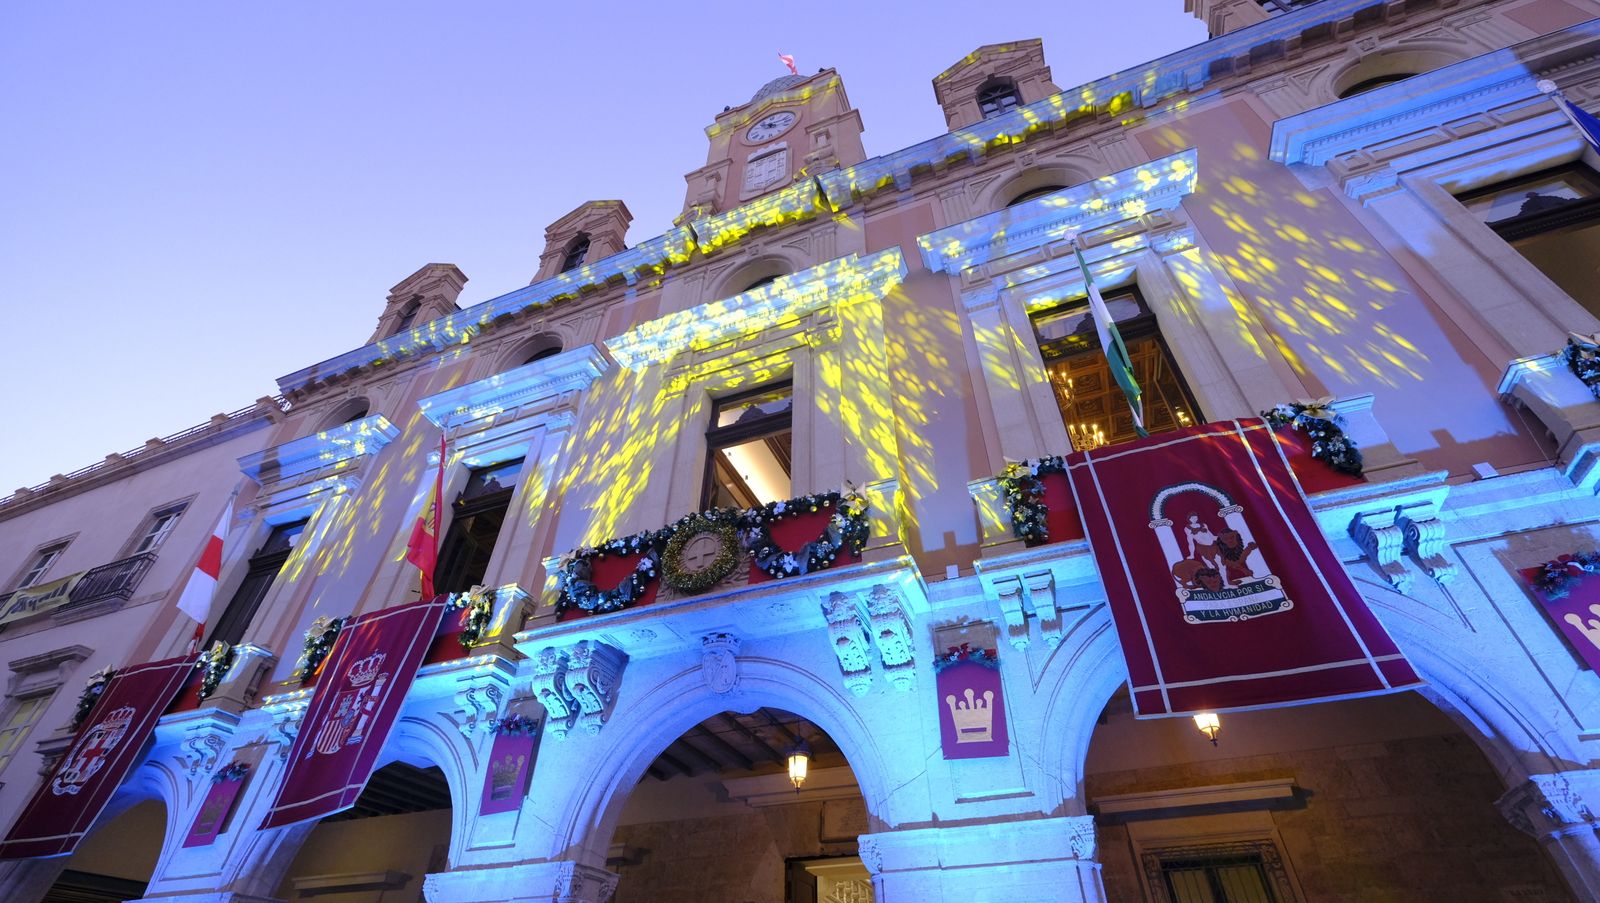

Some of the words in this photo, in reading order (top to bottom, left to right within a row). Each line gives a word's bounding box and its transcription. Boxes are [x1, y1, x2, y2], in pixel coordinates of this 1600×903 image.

[1193, 590, 1237, 600] ANDALVCIA
[1237, 586, 1254, 596] POR
[1255, 584, 1265, 592] SI
[1200, 610, 1206, 618] Y
[1209, 610, 1220, 618] LA
[1222, 601, 1274, 617] HVMANIDAD
